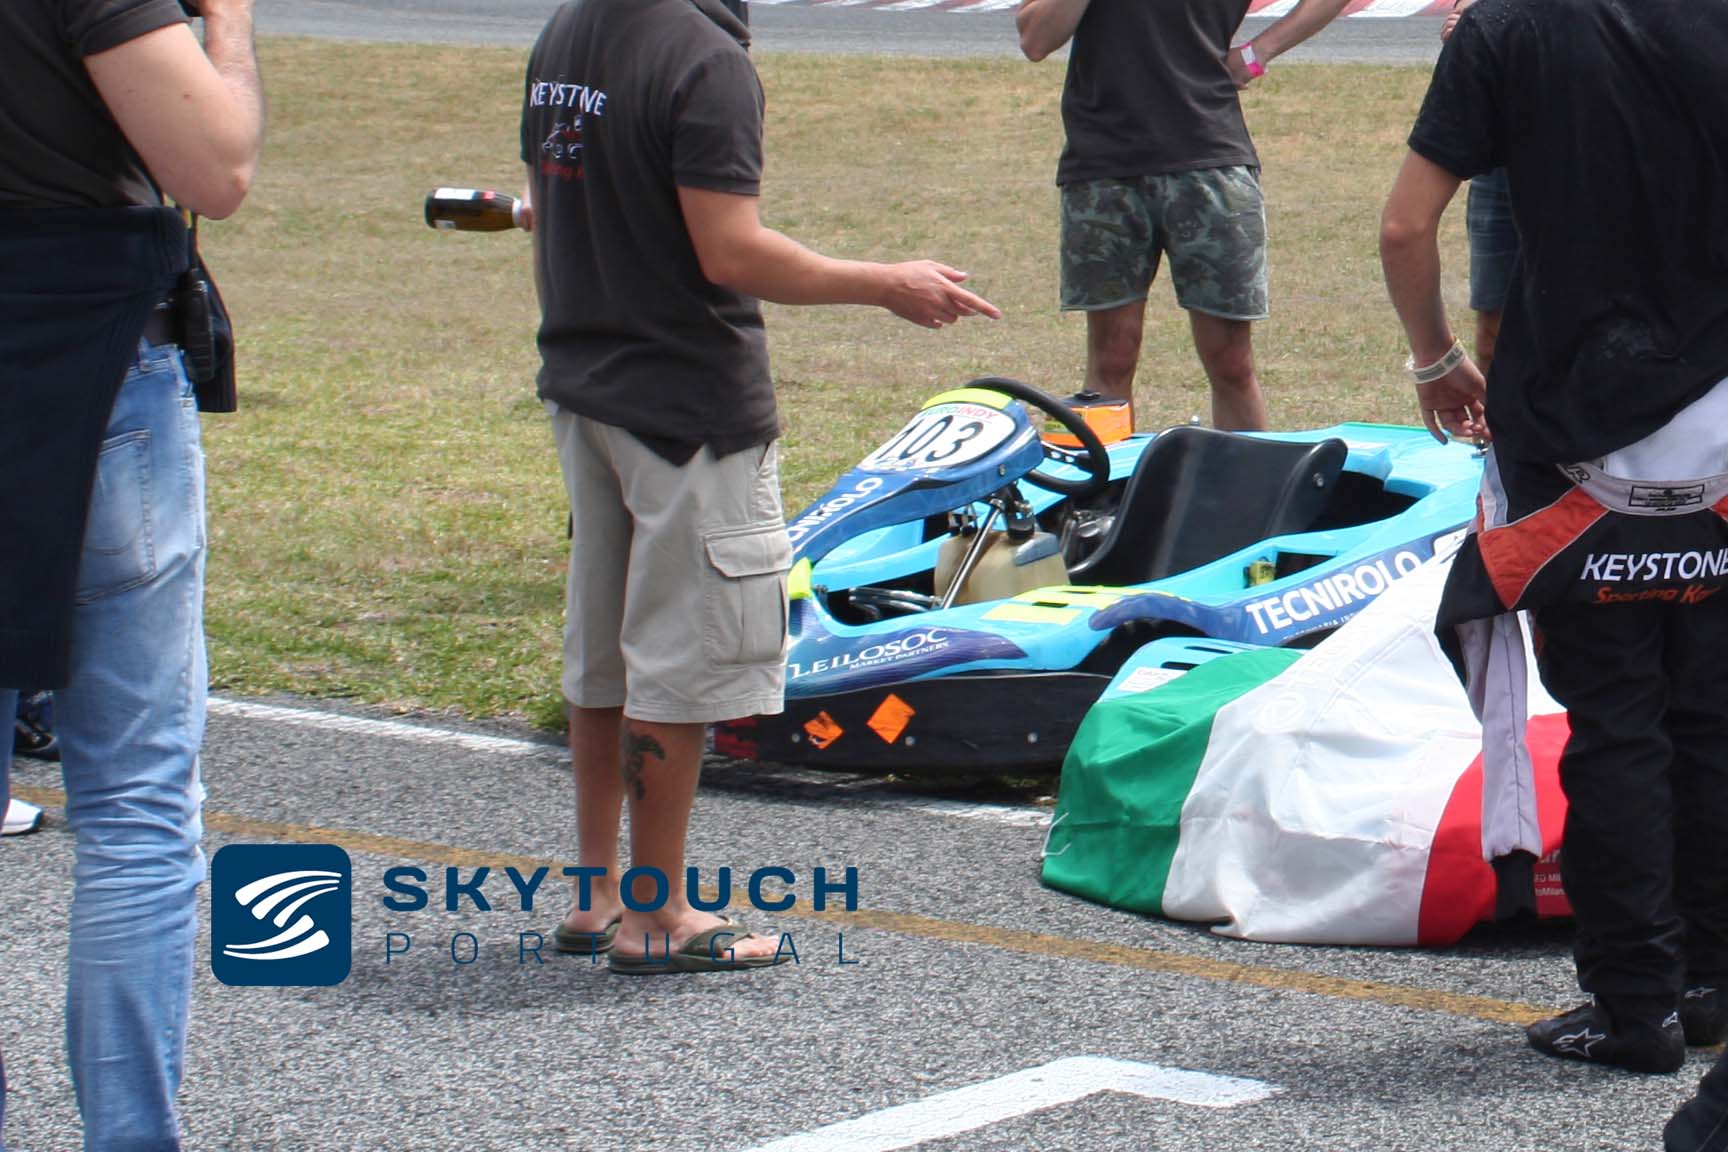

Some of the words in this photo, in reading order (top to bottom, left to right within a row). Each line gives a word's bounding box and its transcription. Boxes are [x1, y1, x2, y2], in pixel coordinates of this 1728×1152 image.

[876, 414, 984, 462] 103
[1245, 551, 1423, 635] TECNIROLO
[788, 628, 948, 679] LEILOSOC
[849, 655, 893, 670] MARKET
